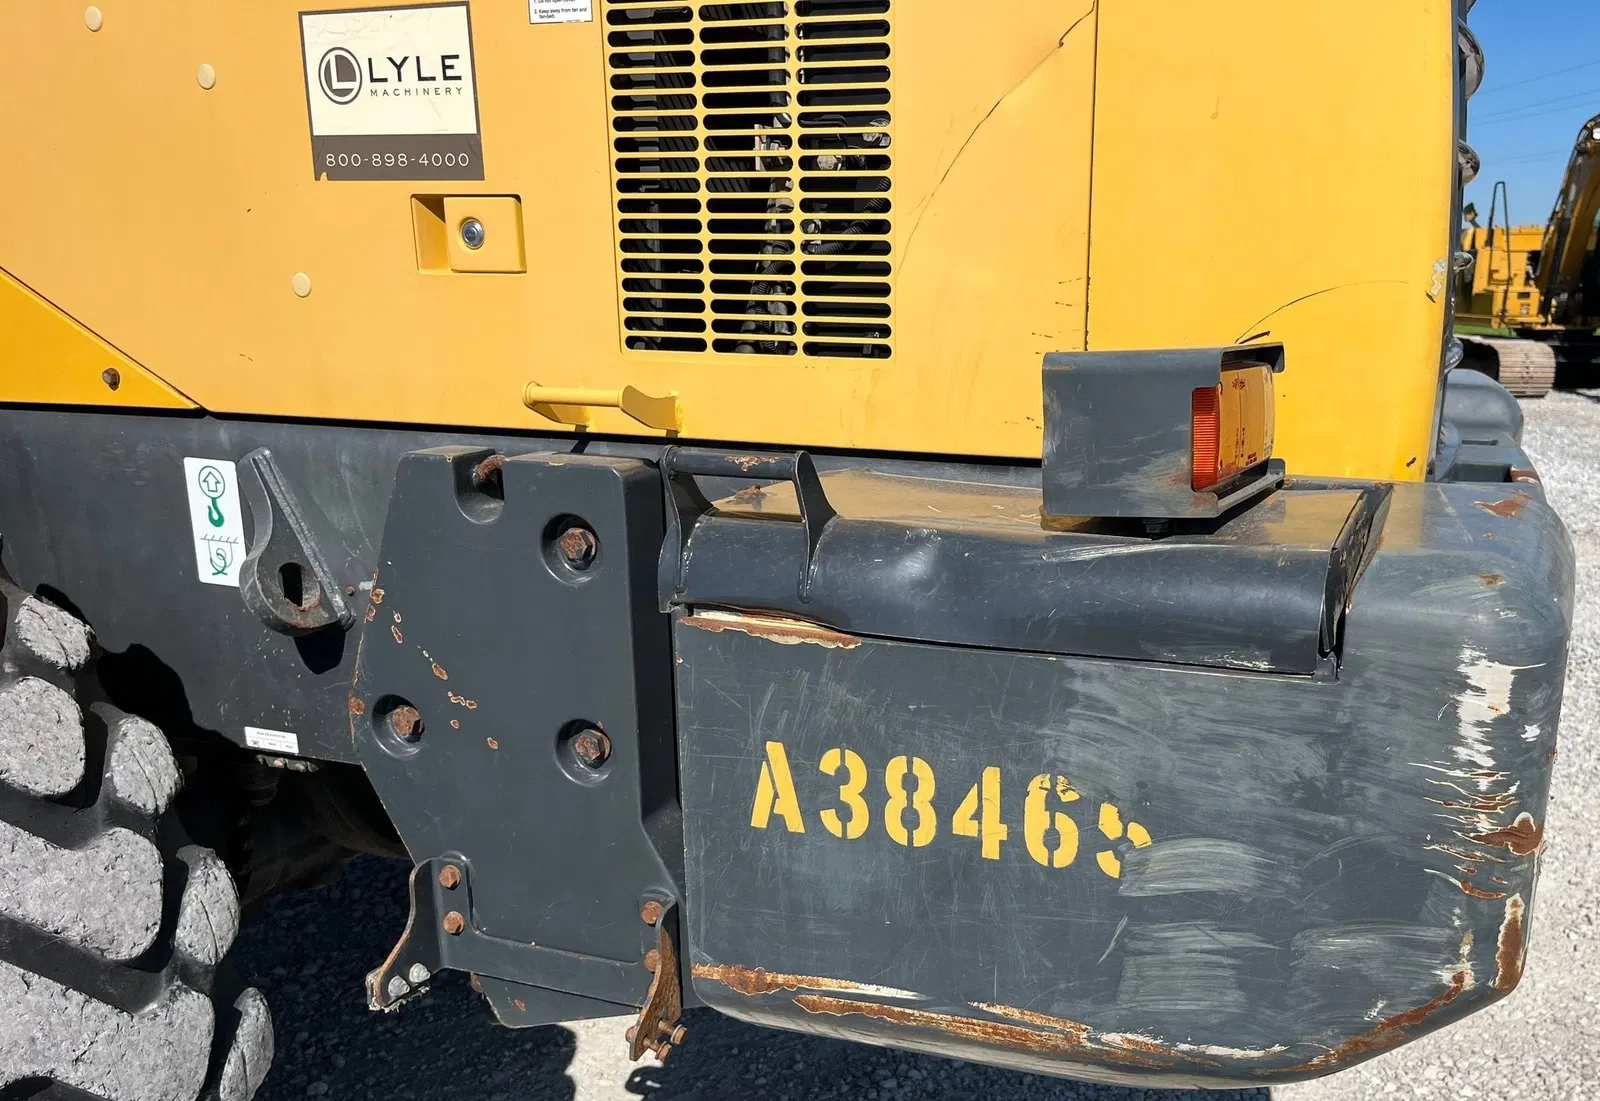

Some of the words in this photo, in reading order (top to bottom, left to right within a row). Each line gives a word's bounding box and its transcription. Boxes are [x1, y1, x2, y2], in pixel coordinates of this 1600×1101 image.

[368, 54, 462, 83] LYLE
[370, 87, 463, 97] MACHINERY
[326, 153, 469, 167] 800-898-4000
